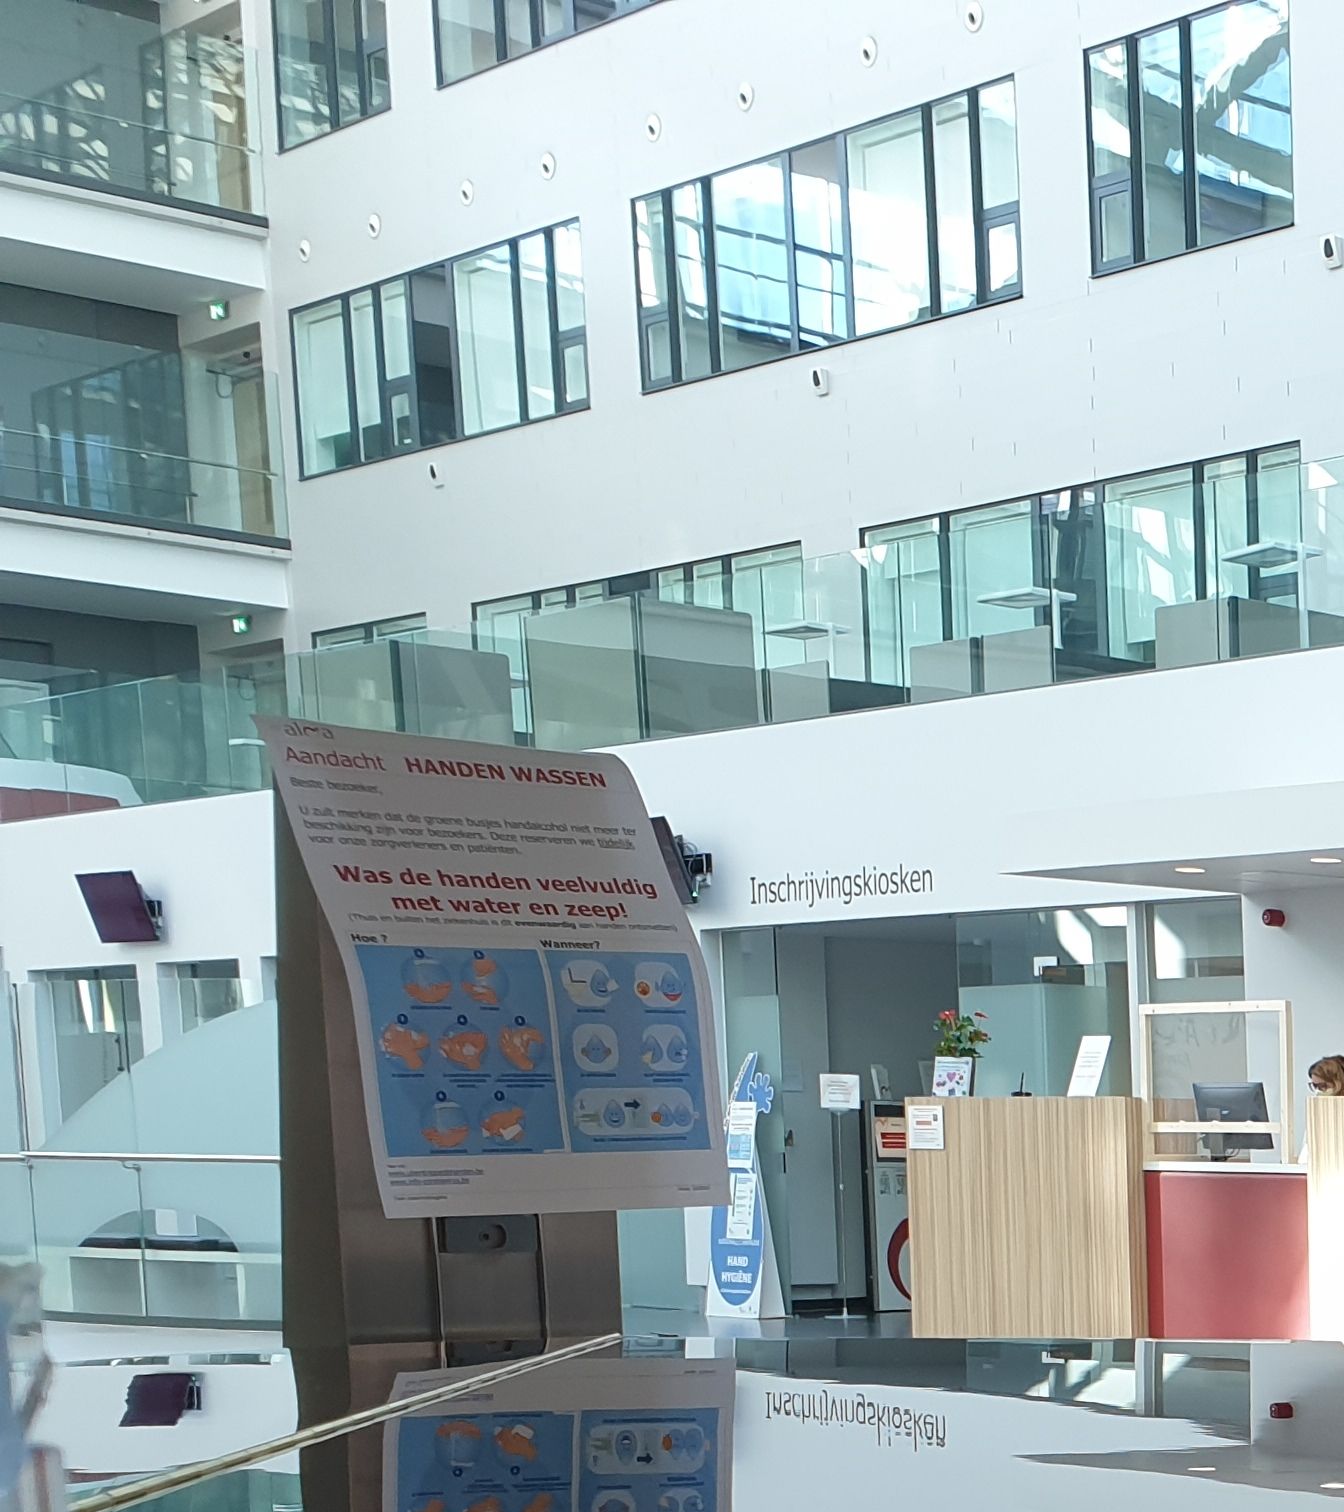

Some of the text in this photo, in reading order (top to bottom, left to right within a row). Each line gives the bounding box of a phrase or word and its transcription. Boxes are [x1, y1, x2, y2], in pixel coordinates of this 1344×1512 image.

[286, 746, 607, 788] Aandacht HANDEN WASSEN
[333, 864, 658, 899] Was de handen veelvuldig
[750, 863, 934, 908] Inschrijvingskiosken
[392, 895, 628, 921] met water en zeep!
[350, 933, 378, 943] Hoe
[539, 939, 600, 950] Wanneer?
